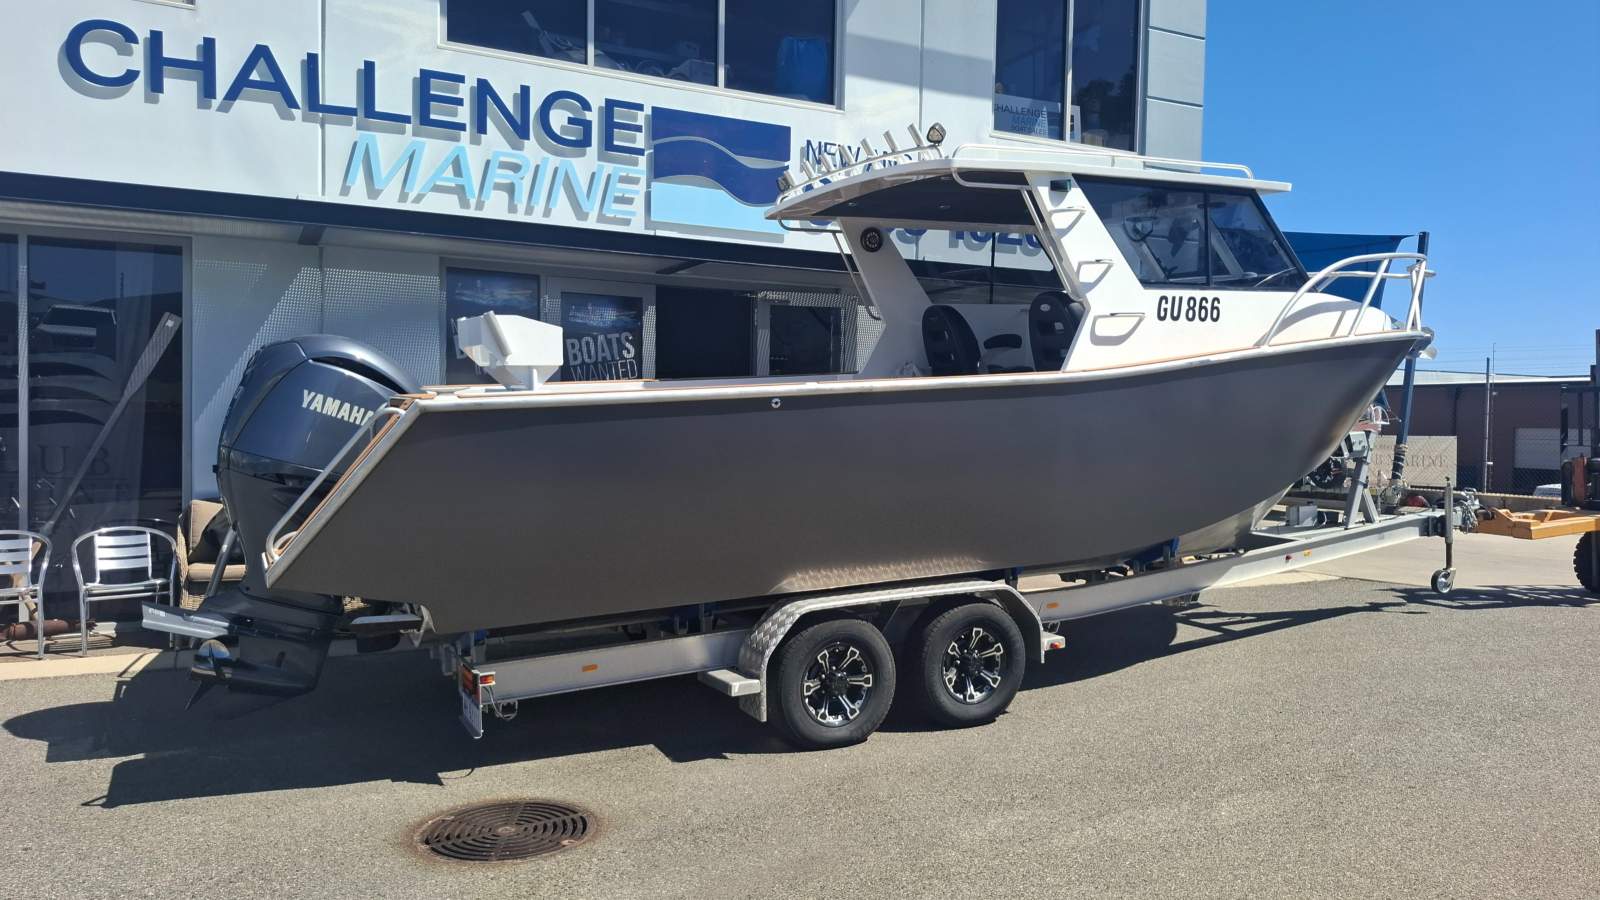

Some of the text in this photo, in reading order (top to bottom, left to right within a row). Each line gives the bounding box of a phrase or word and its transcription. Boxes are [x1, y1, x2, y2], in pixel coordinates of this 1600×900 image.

[65, 19, 646, 156] CHALLENGE
[346, 132, 647, 217] MARINE
[566, 331, 635, 367] BOATS
[570, 358, 638, 381] WANTED
